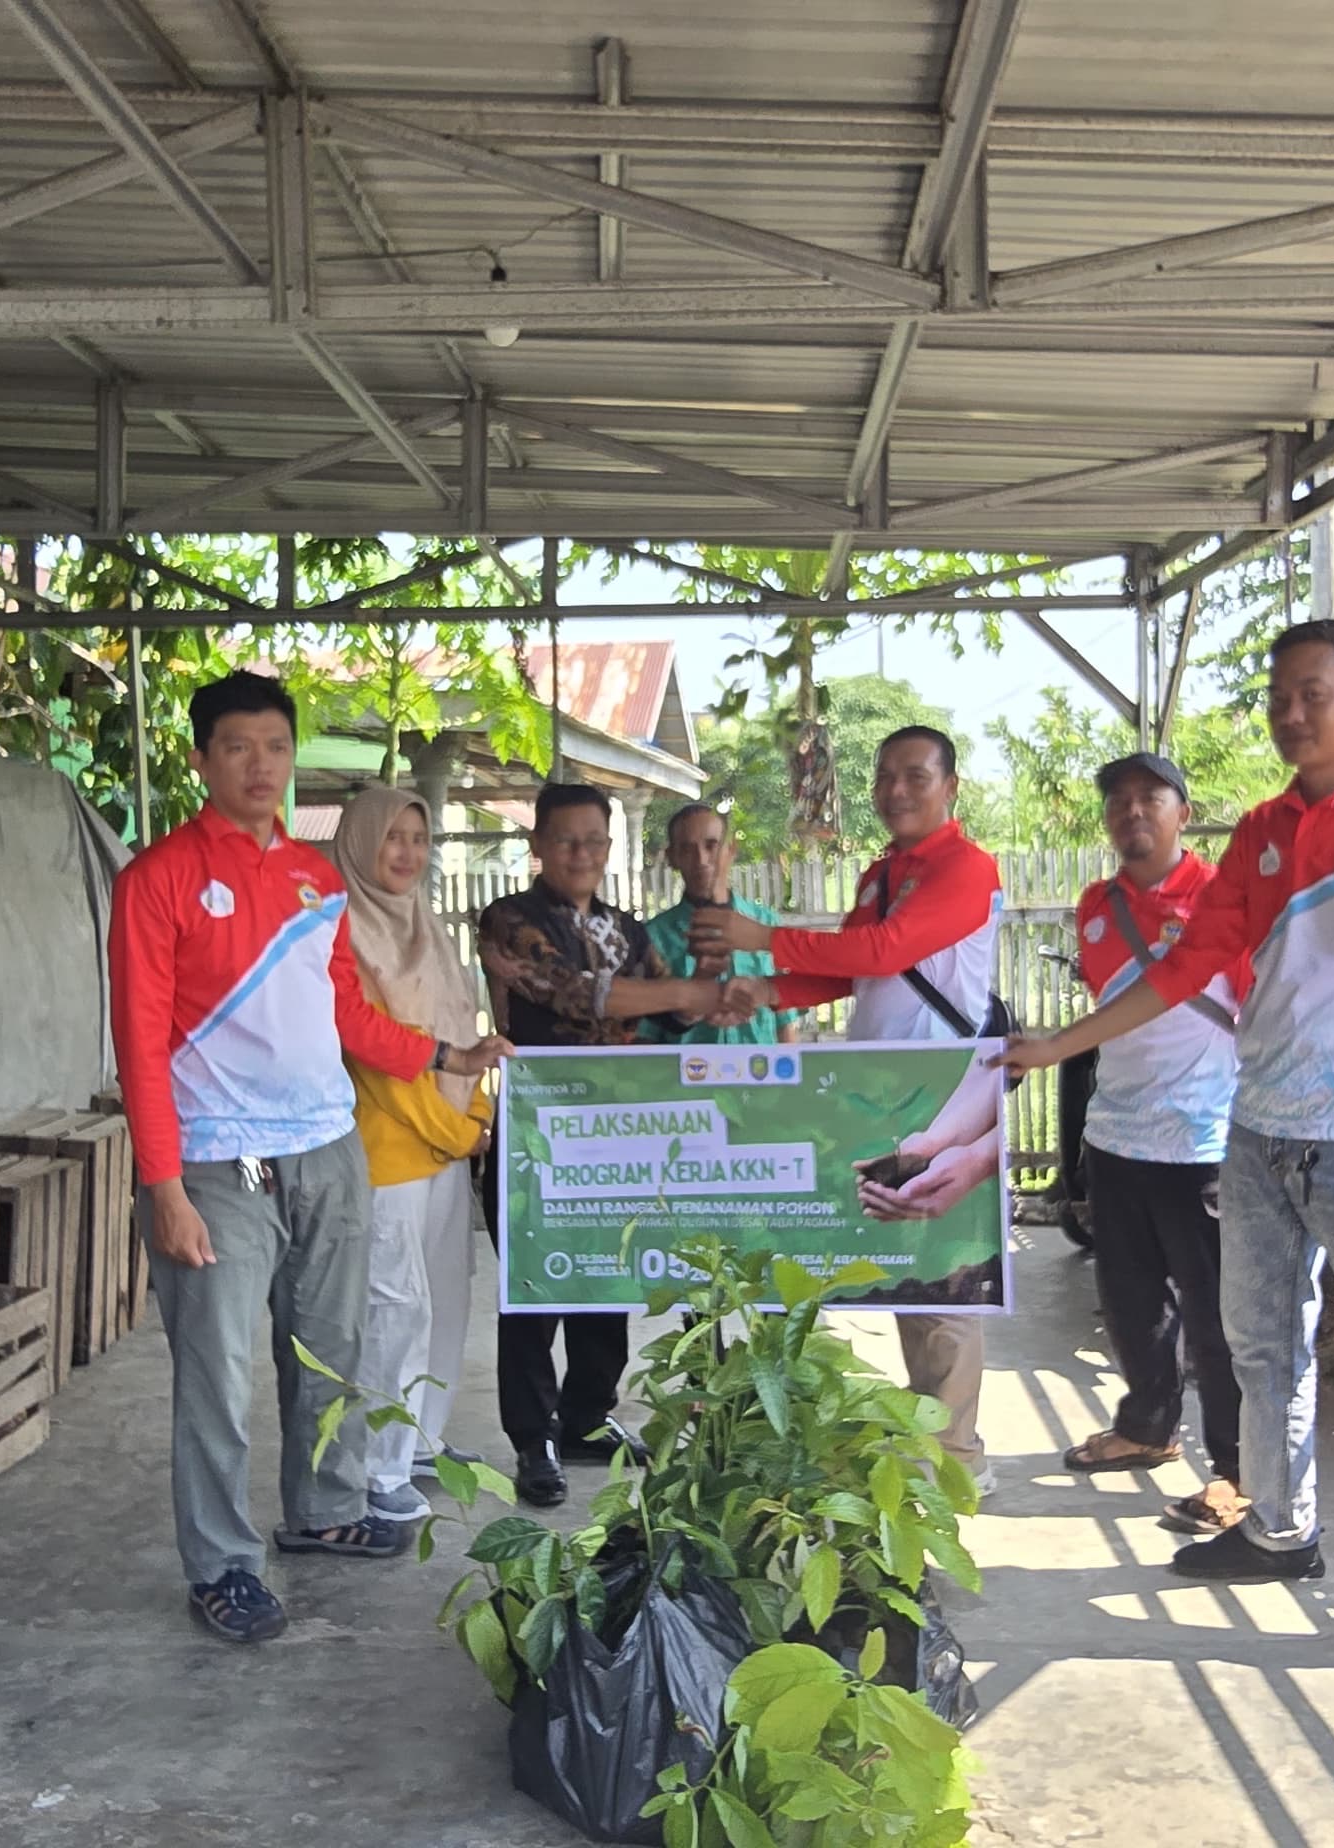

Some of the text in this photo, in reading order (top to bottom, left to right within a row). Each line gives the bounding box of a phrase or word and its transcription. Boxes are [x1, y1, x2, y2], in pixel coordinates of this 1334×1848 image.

[550, 1109, 713, 1139] PELAKSANAAN
[552, 1161, 652, 1186] PROGRAM
[660, 1158, 727, 1183] KERJA
[730, 1157, 775, 1182] KKN
[543, 1202, 600, 1215] DALAM
[672, 1201, 774, 1214] PENANAMAN
[776, 1201, 837, 1214] POHON
